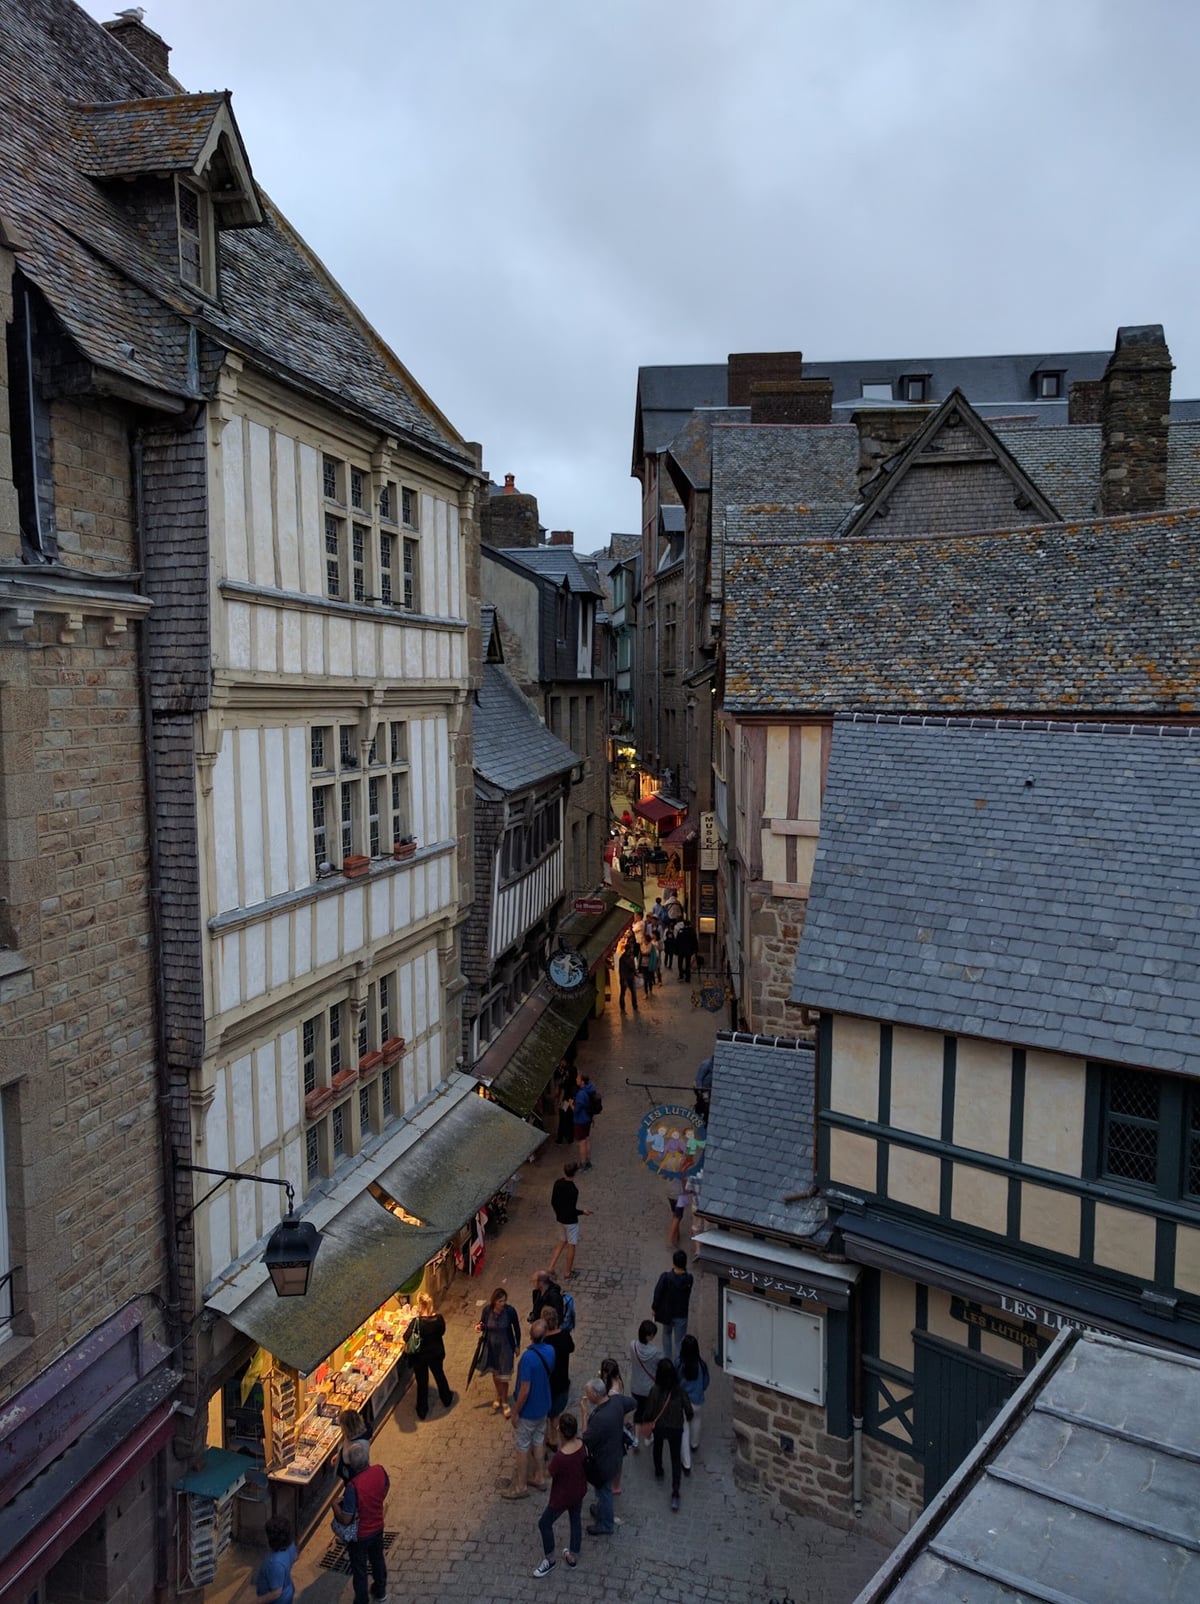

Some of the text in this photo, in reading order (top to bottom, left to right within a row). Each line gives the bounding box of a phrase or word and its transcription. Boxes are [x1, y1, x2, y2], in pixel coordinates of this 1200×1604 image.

[644, 1110, 662, 1127] LES
[963, 1308, 988, 1328] LES
[1001, 1295, 1037, 1321] LES
